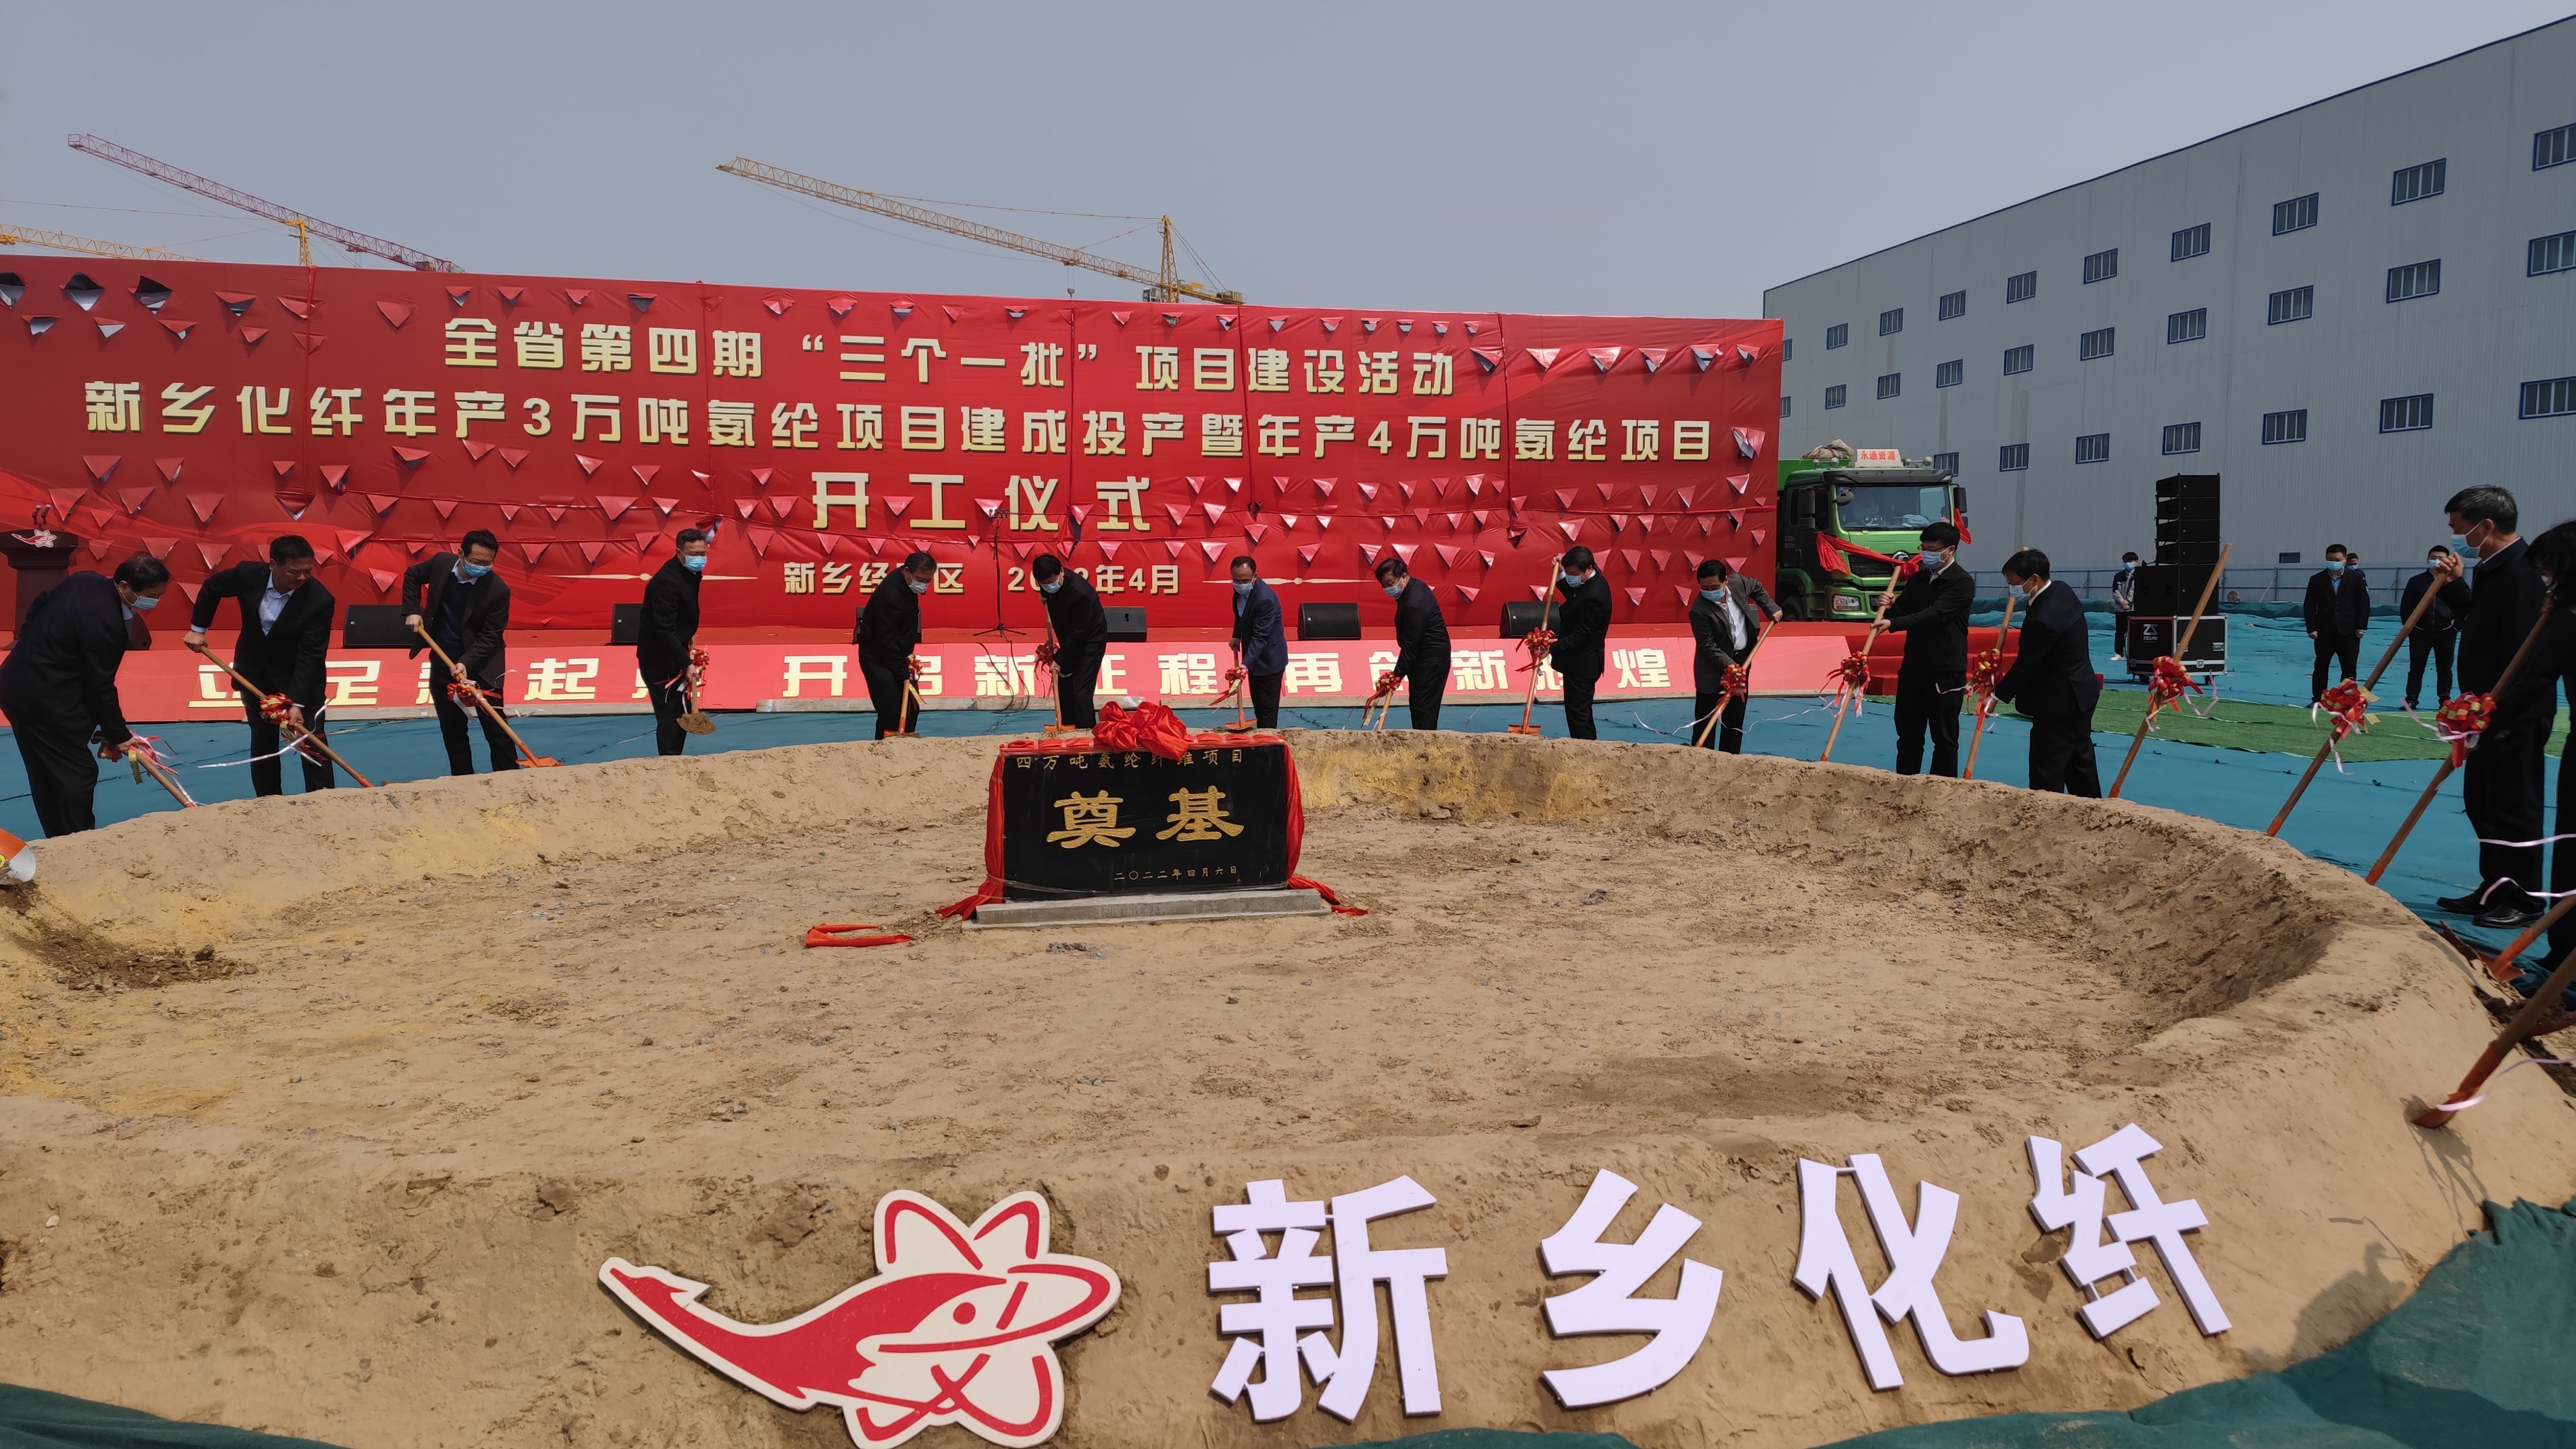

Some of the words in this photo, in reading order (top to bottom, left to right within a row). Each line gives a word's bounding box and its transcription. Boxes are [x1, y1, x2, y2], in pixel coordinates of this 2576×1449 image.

[444, 317, 1455, 396] 全省第四期“三个一批”项目建设活动
[84, 380, 1711, 462] 新乡化纤年产3万吨氨纶项目建成投产暨年产4万吨氨纶项目
[1861, 450, 1896, 460] 永通资源
[811, 471, 1151, 531] 开工仪式
[784, 562, 964, 595] 新乡经区
[1008, 564, 1180, 595] 2年4月
[1046, 785, 1245, 850] 奠基
[1208, 1122, 2231, 1423] 新乡化纤
